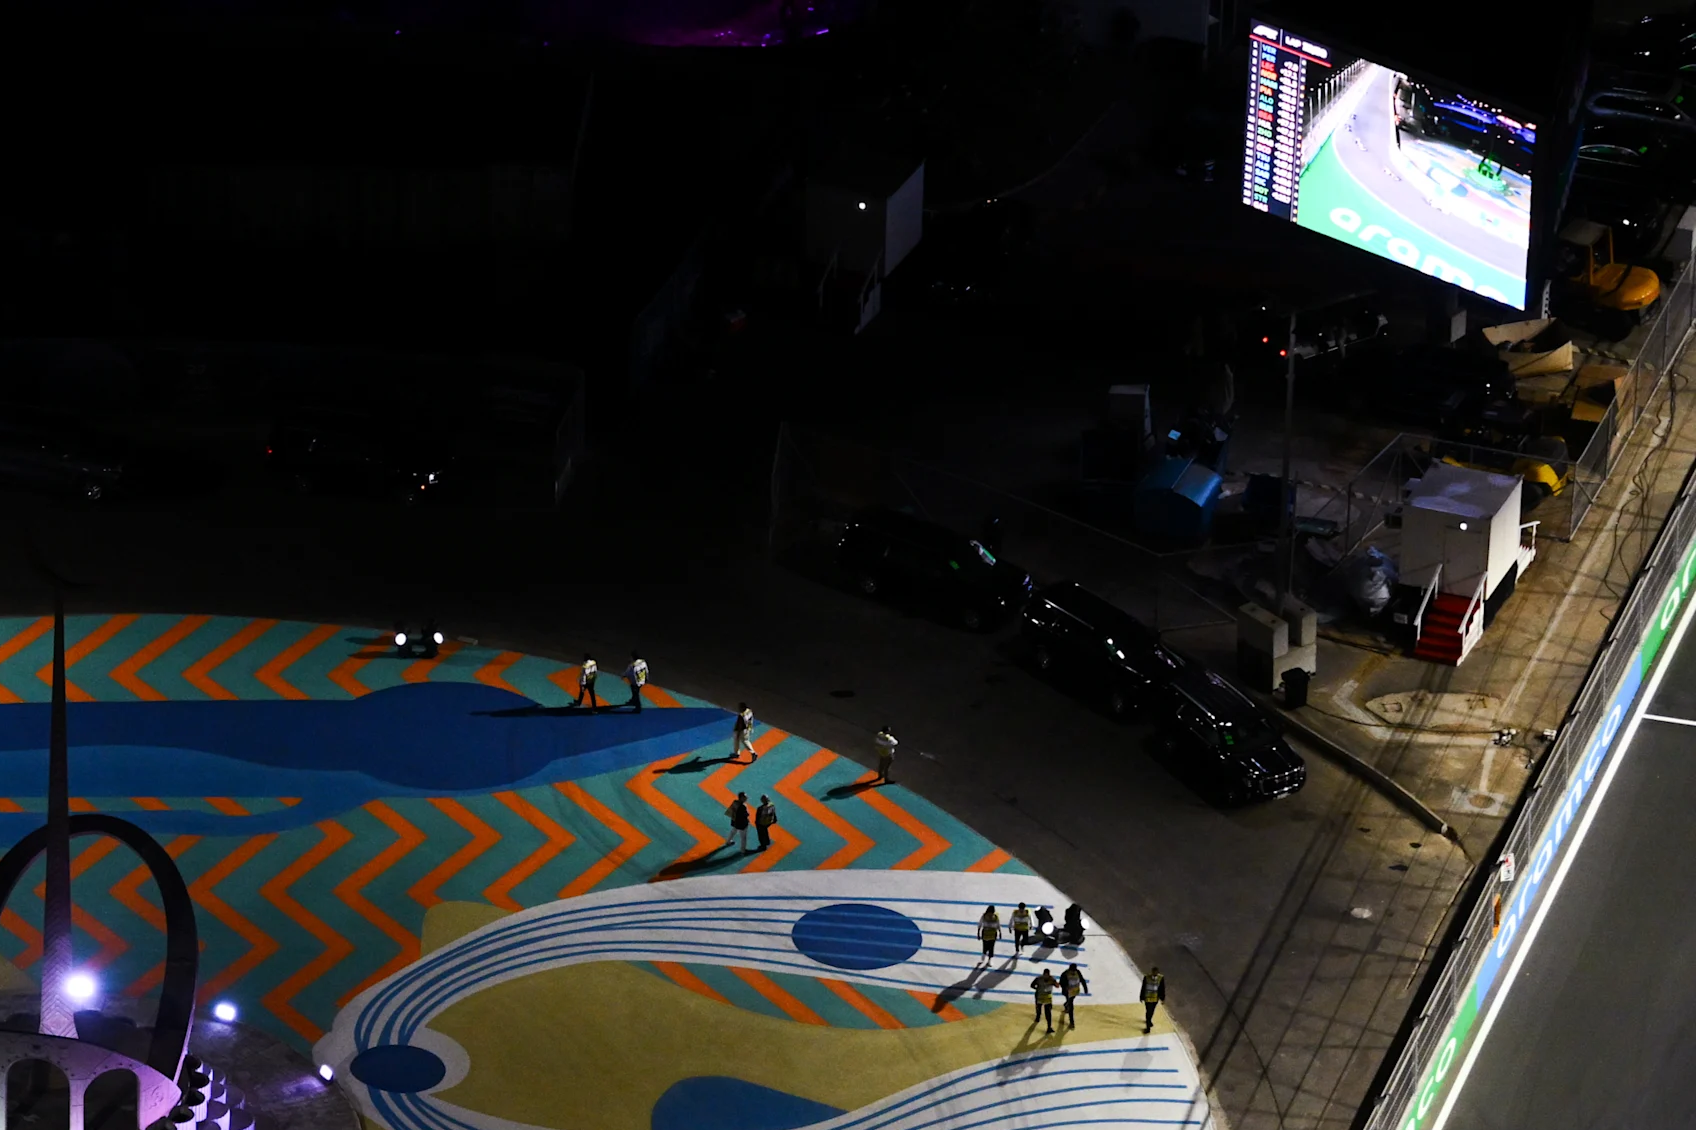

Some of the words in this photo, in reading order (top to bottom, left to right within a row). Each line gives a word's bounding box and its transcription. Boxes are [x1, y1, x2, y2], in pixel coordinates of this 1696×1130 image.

[1261, 43, 1277, 55] VER
[1259, 94, 1274, 105] ALO
[1329, 207, 1508, 303] aram
[1496, 705, 1622, 959] aramco
